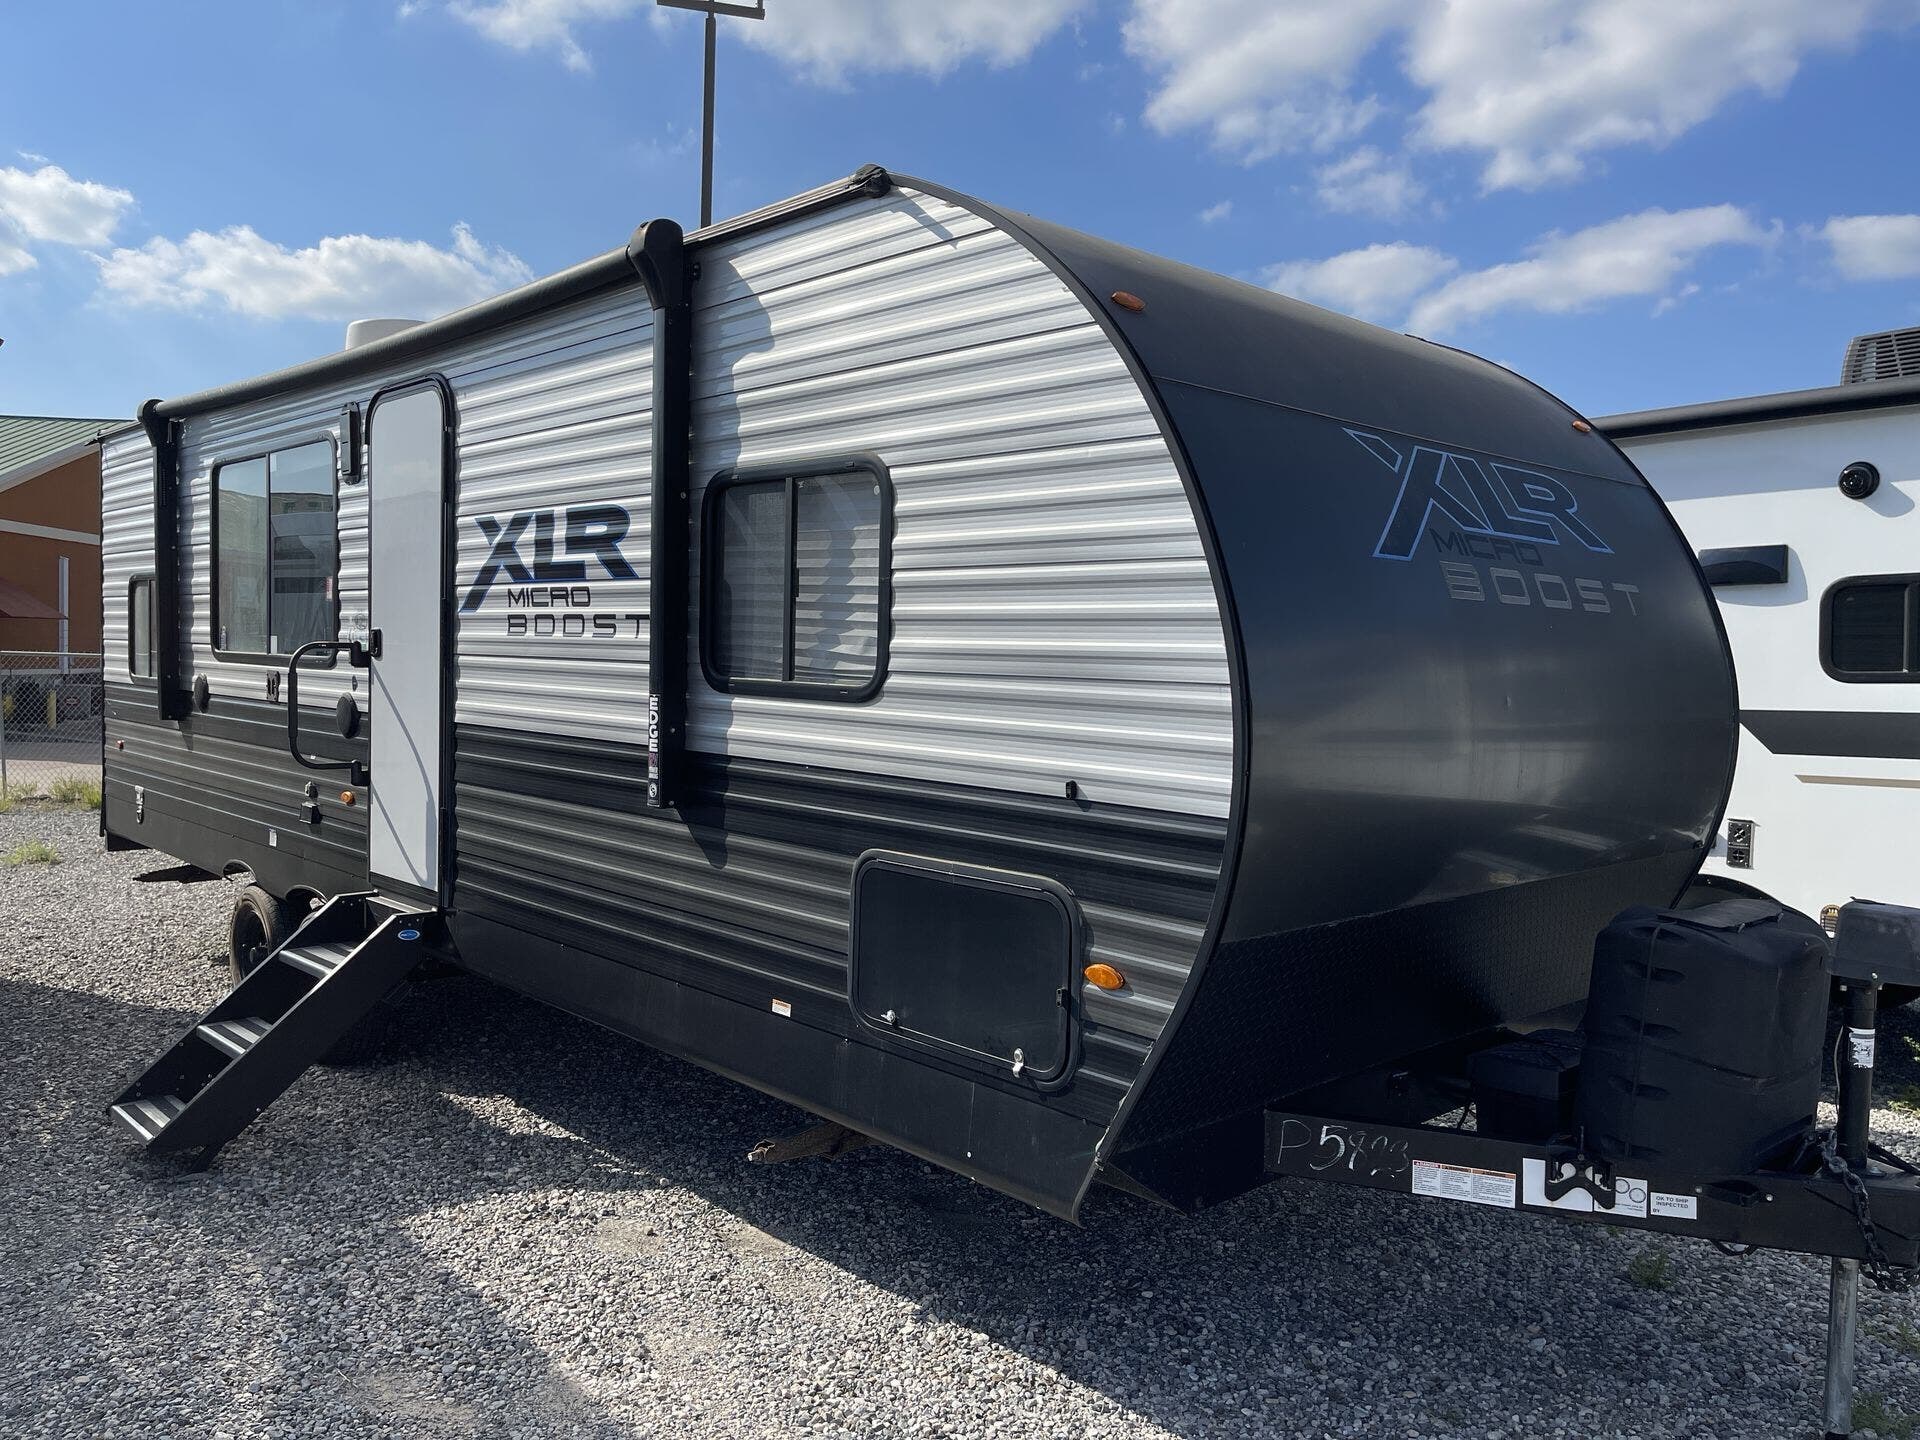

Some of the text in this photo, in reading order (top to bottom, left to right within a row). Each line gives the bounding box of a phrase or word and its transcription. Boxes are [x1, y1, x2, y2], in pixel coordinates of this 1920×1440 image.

[1342, 427, 1614, 561] XLR
[458, 504, 640, 614] XLR
[1429, 528, 1544, 567] MICRO
[507, 586, 591, 608] MICRO
[1439, 560, 1640, 616] BOOST
[507, 613, 650, 638] BOOST
[1655, 1201, 1689, 1209] INSPECTED
